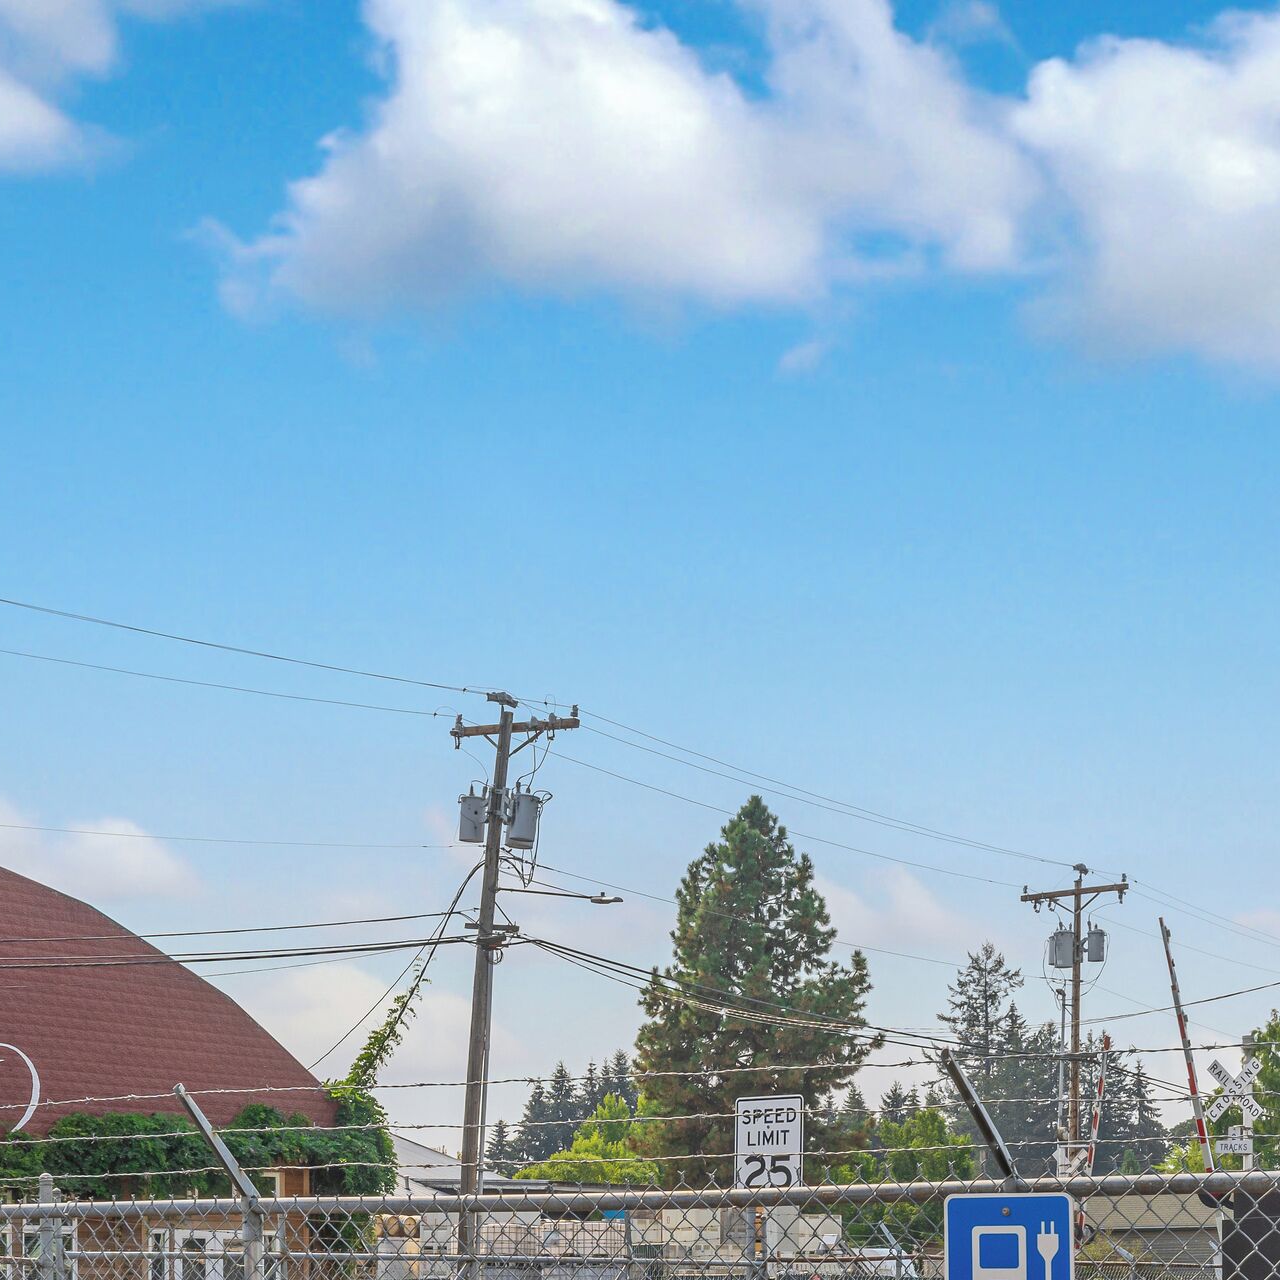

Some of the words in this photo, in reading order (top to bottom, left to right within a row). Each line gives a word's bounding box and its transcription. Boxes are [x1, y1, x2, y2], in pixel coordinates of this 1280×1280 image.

[1209, 1060, 1260, 1118] CROSSING
[742, 1107, 797, 1125] SPEED
[747, 1130, 790, 1147] LIMIT
[1220, 1143, 1248, 1151] TRACKS
[743, 1154, 793, 1188] 25
